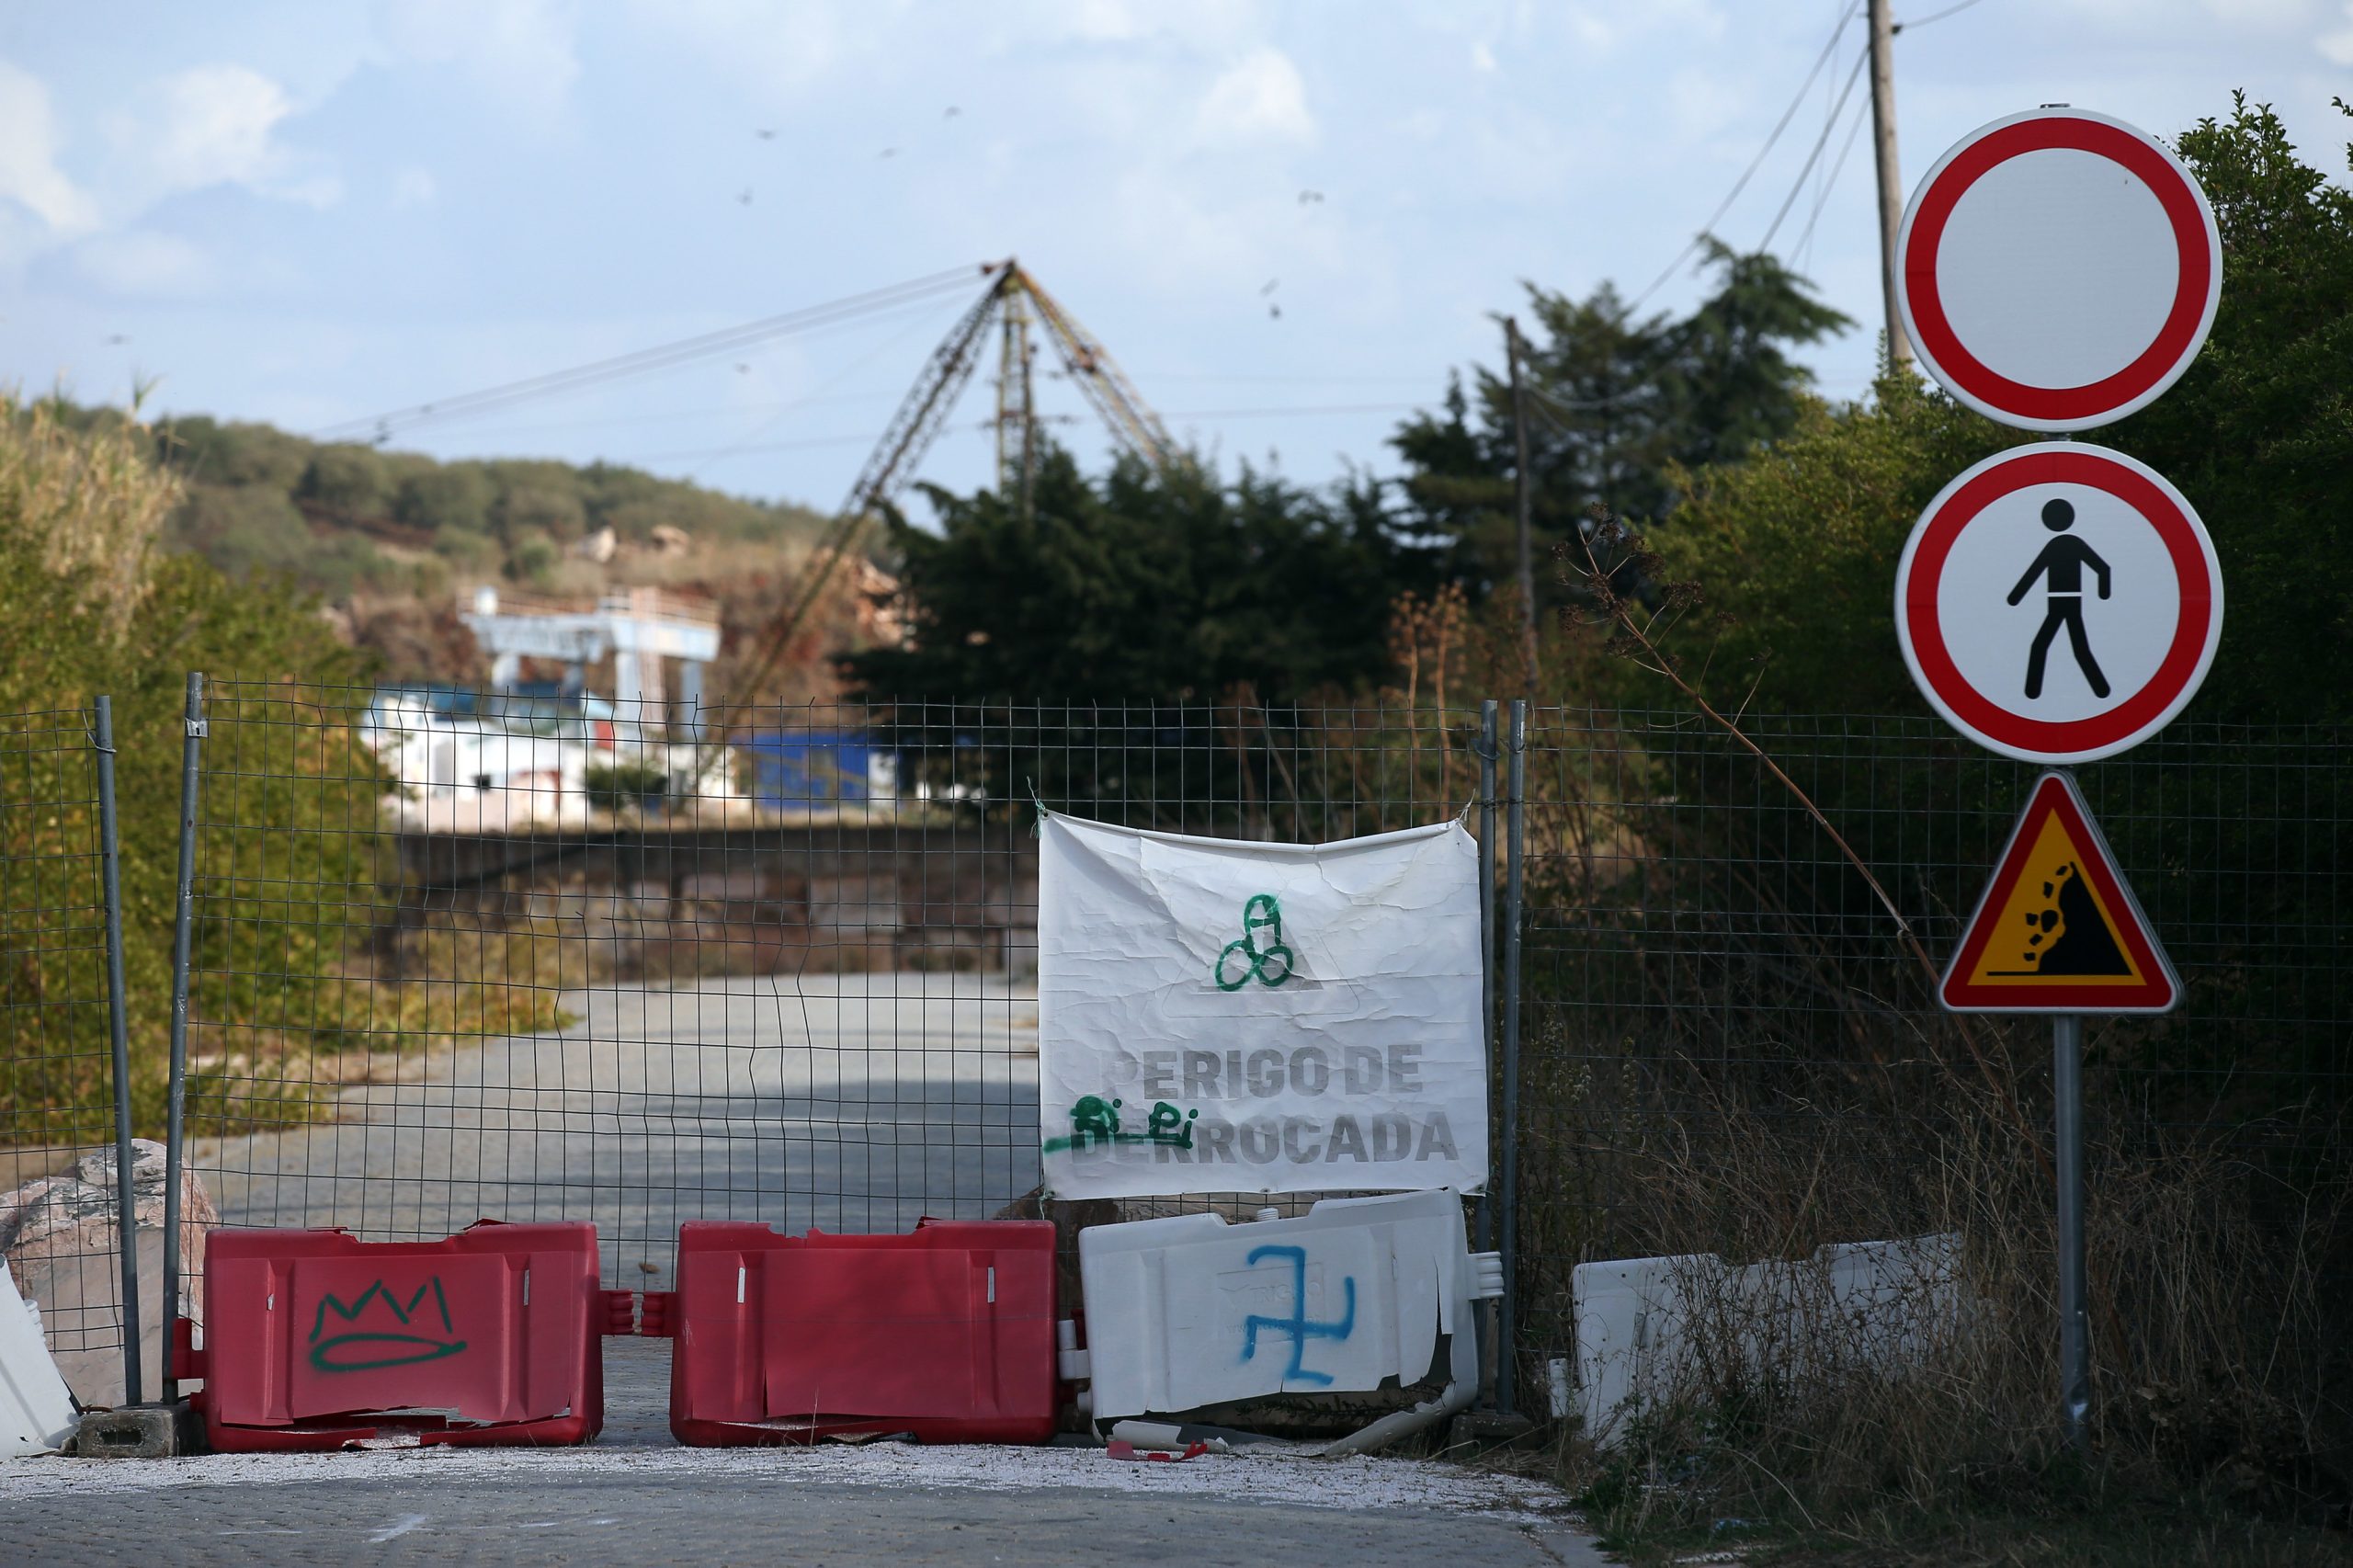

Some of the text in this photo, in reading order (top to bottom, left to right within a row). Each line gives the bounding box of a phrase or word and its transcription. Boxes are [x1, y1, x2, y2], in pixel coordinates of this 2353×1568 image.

[1103, 1044, 1423, 1100] PERIGO DE
[1071, 1111, 1460, 1165] DERROCADA
